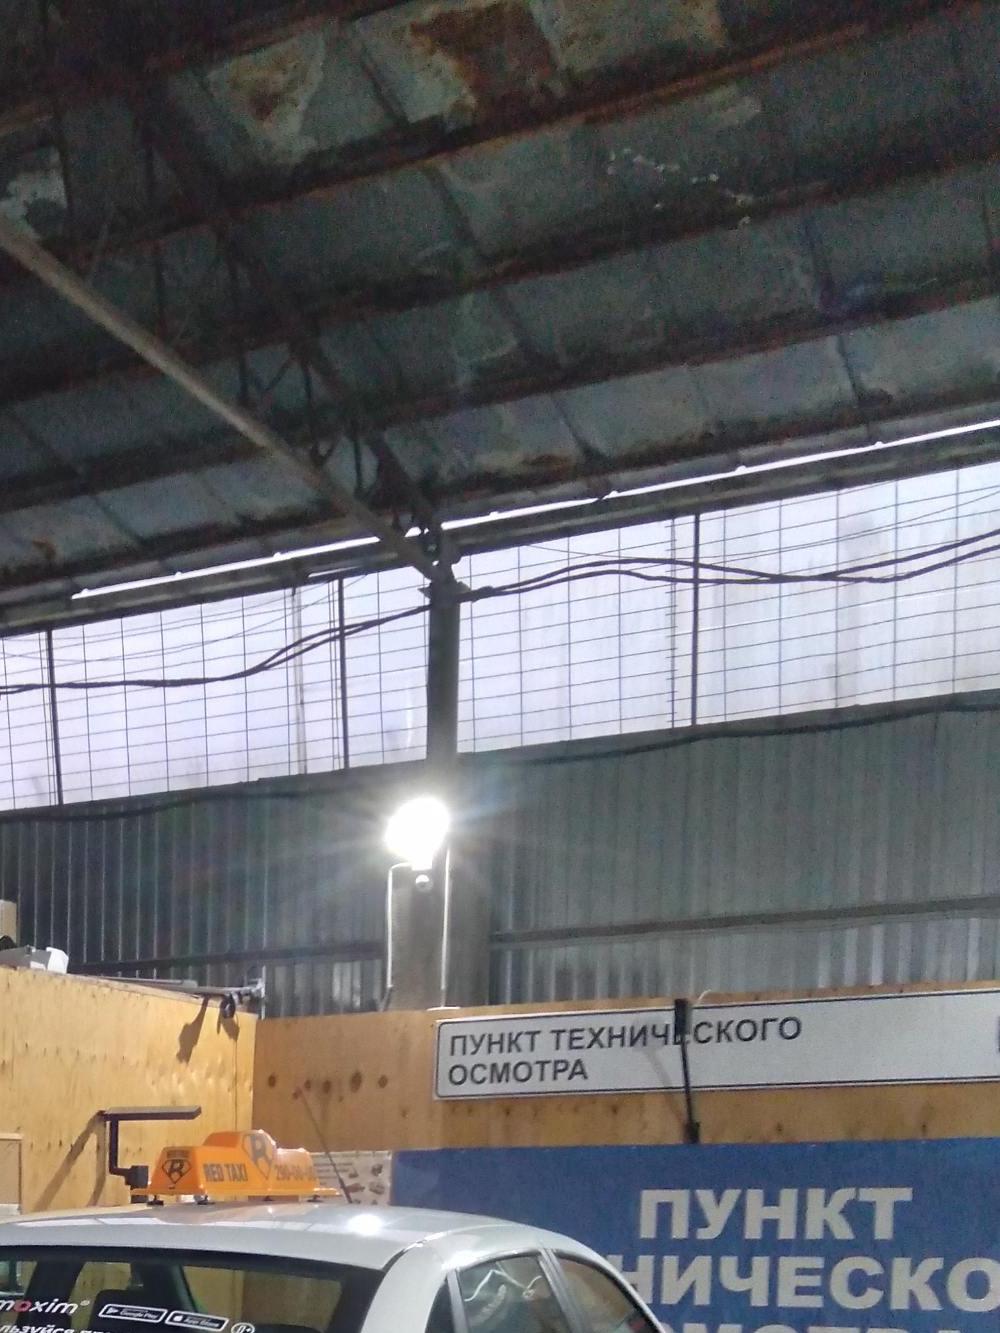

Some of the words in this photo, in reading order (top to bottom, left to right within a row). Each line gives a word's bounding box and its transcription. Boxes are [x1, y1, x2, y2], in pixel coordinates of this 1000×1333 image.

[450, 1030, 541, 1057] ПУНКТ
[449, 1059, 588, 1086] ОСМОТРА
[224, 1164, 248, 1182] TAXI
[640, 1187, 913, 1240] ПУНКТ
